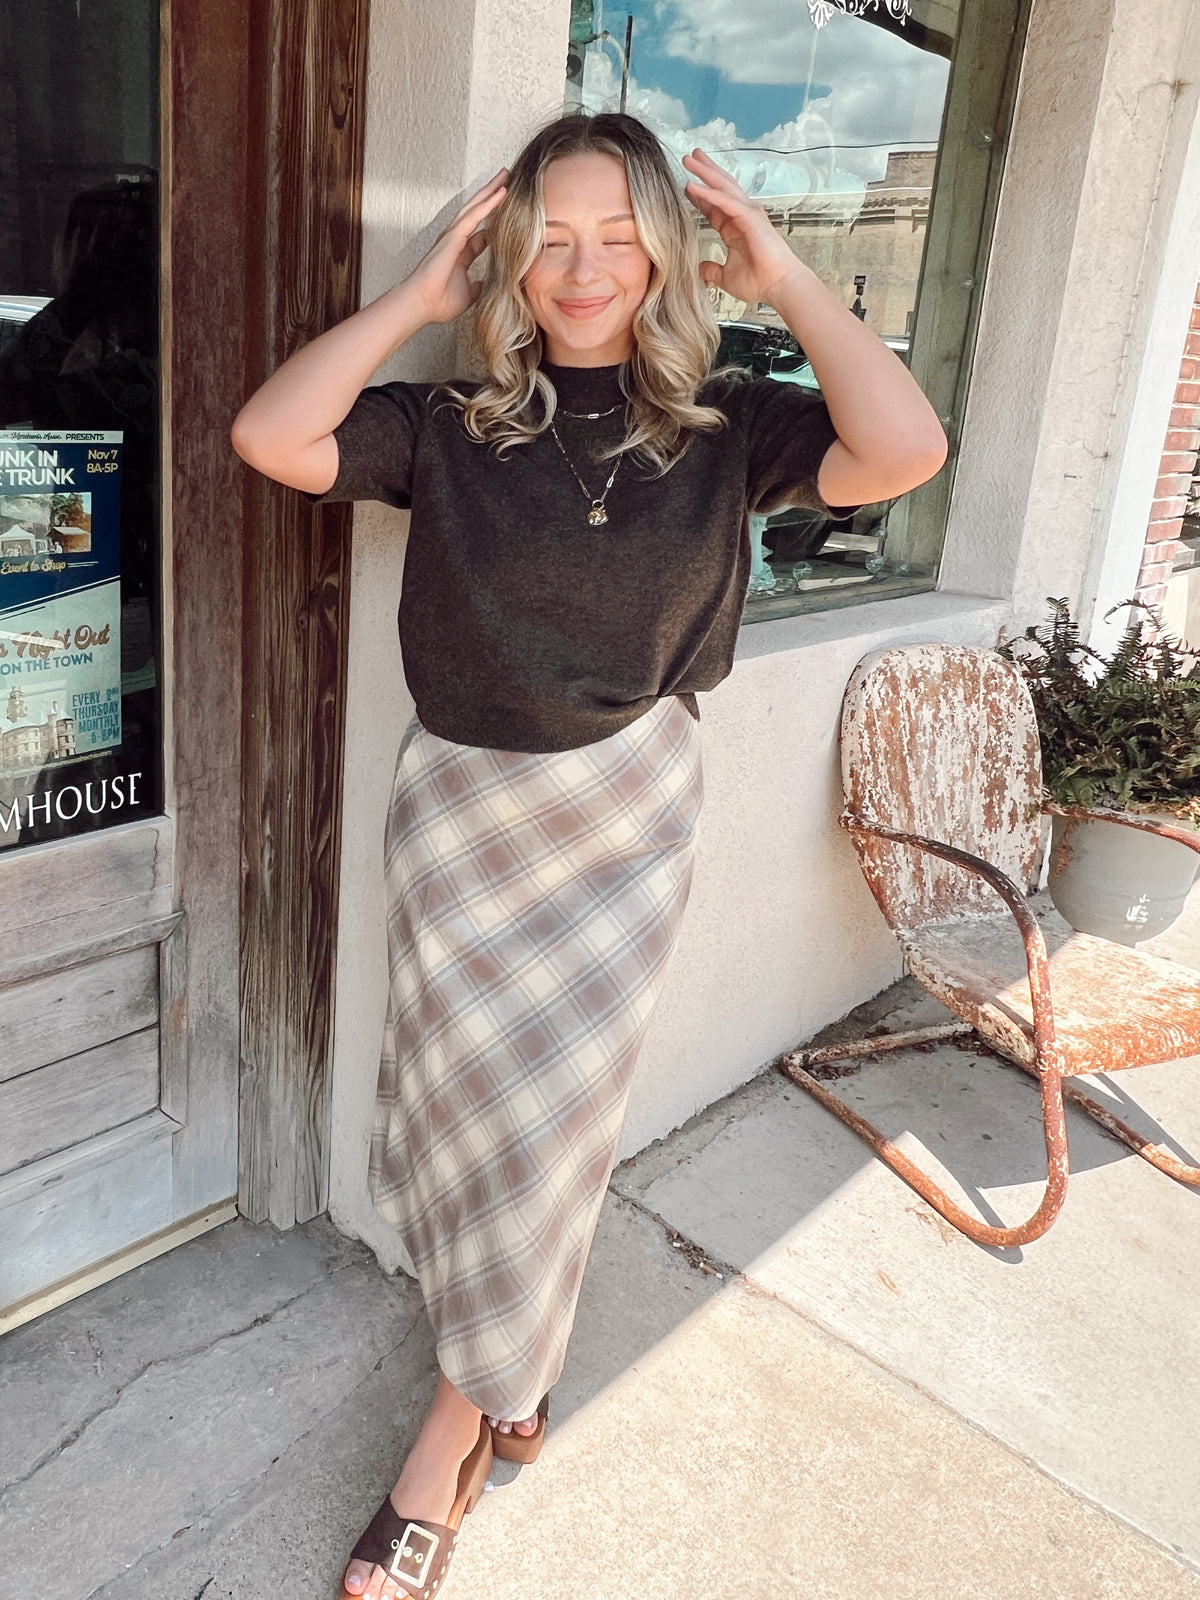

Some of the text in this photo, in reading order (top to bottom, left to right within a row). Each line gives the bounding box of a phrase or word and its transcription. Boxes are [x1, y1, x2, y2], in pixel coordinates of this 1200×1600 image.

[65, 433, 105, 441] PRESENTS
[38, 450, 58, 467] IN
[88, 449, 118, 460] Nov 7
[87, 462, 119, 473] 8A-5P
[5, 468, 75, 486] TRUNK
[1, 561, 29, 575] Event
[74, 623, 110, 650] Out
[0, 652, 93, 675] ON THE TOWN
[72, 690, 100, 708] EVERY
[72, 700, 119, 720] THURSDAY
[79, 714, 119, 733] MONTHLY
